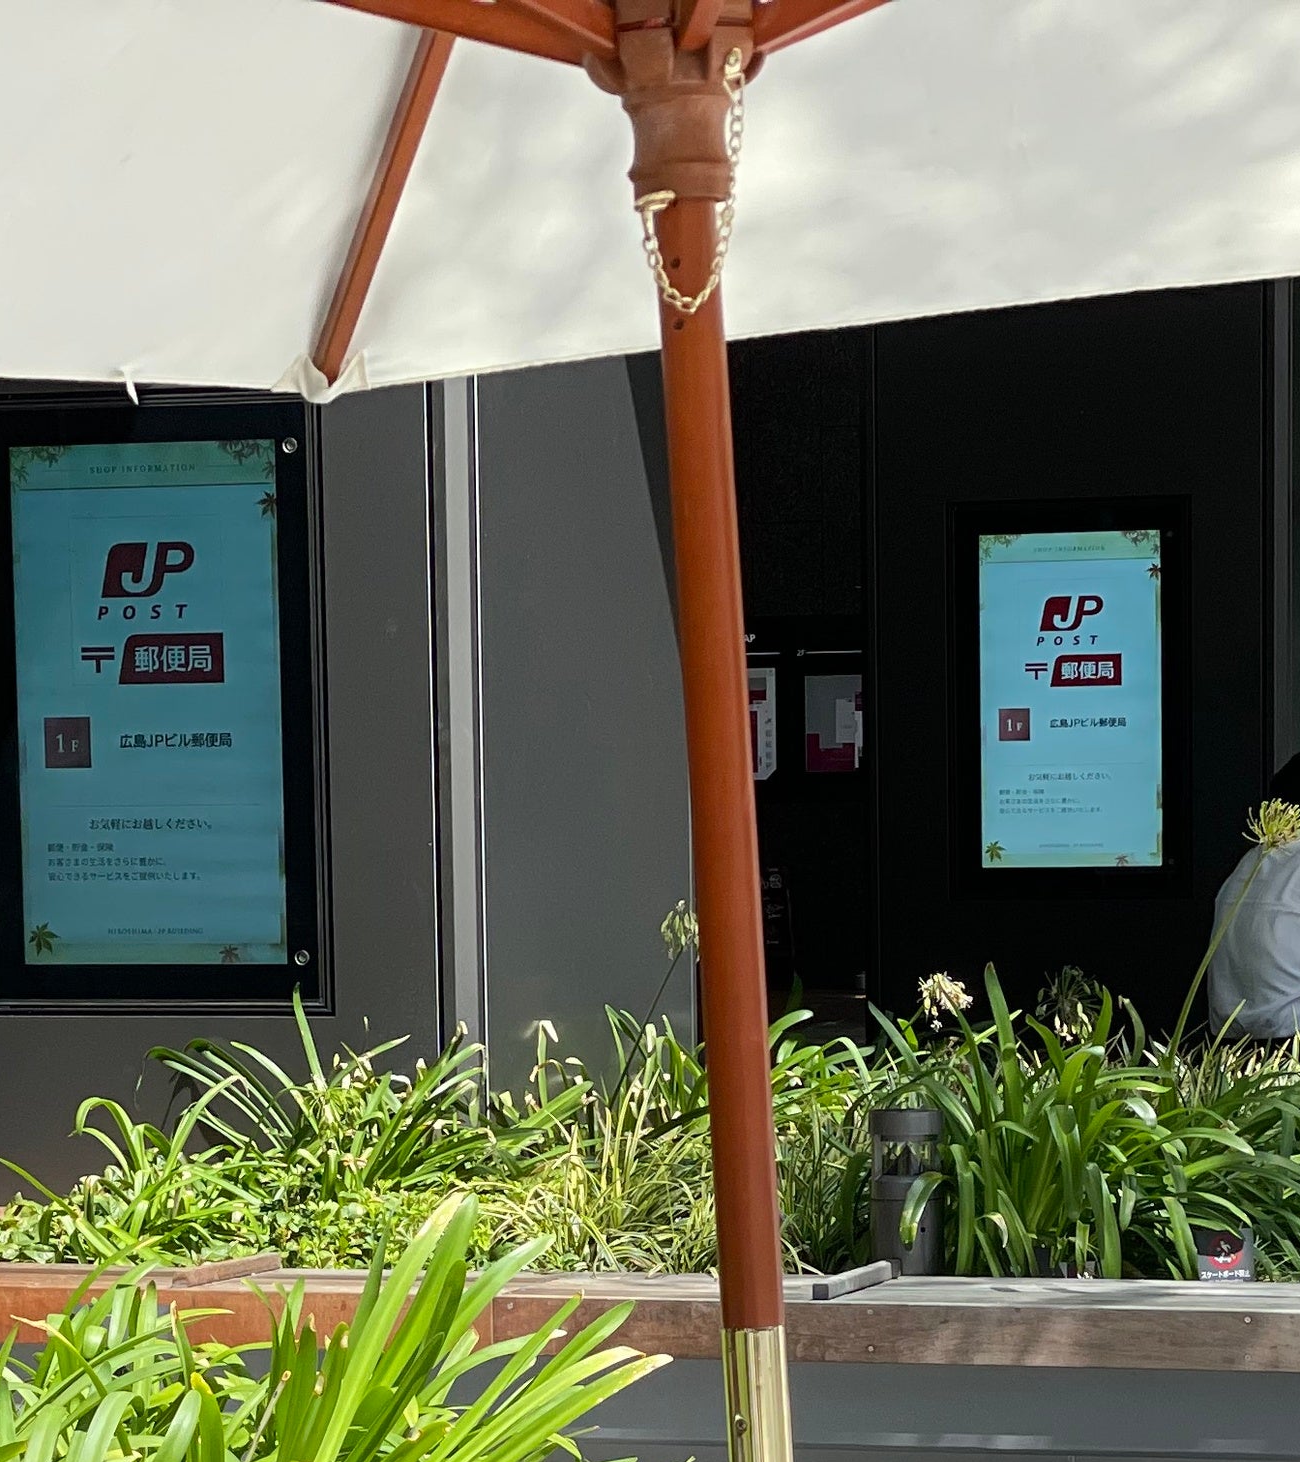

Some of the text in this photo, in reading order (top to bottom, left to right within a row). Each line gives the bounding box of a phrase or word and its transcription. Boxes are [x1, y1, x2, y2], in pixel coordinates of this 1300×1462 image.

[89, 463, 195, 474] SHOP INFORMATION
[101, 541, 195, 598] JP
[97, 604, 188, 620] POST
[1040, 595, 1104, 631] JP
[1037, 635, 1098, 646] POST
[134, 645, 213, 673] 郵便局
[1061, 661, 1114, 680] 郵便局
[1049, 717, 1127, 728] 広島JPビル郵便局
[119, 732, 232, 748] 広島JPビル郵便局
[89, 818, 212, 830] お気軽にお越しください。
